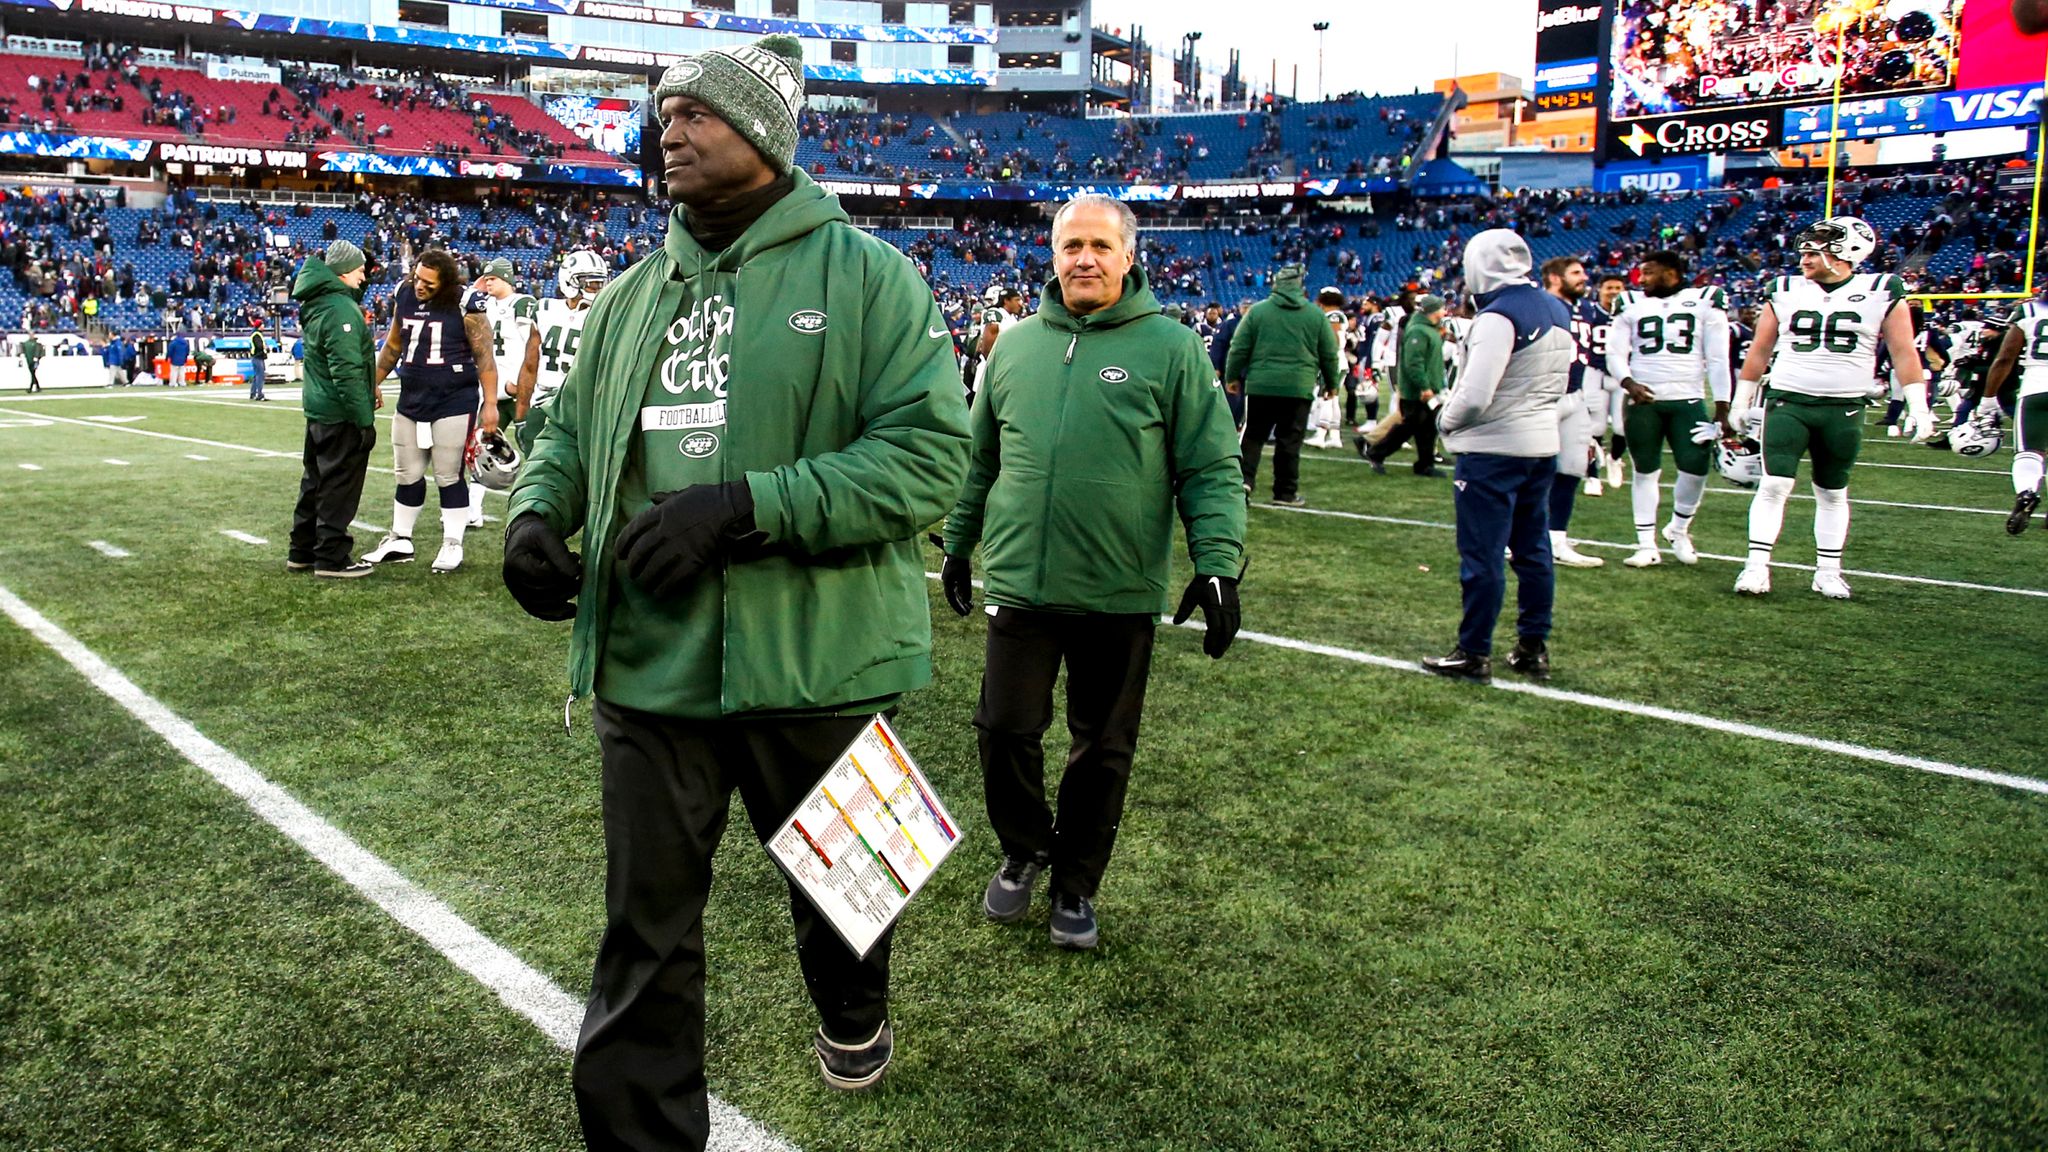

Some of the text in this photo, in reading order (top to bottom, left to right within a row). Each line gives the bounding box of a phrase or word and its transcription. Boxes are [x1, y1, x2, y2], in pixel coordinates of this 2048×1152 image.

[81, 0, 214, 25] PATRIOTS WIN
[583, 1, 684, 25] PATRIOTS WIN
[1536, 5, 1603, 32] jetBlue
[585, 47, 655, 66] PATRIOTS
[731, 46, 789, 89] ORK
[231, 68, 270, 79] Putnam
[1698, 71, 1777, 97] Party
[1537, 91, 1594, 109] 44:34
[1940, 87, 2044, 122] VISA
[1656, 119, 1769, 148] CROSS
[160, 143, 306, 168] PATRIOTS WIN
[872, 183, 901, 197] WIN
[1182, 183, 1295, 199] PATRIOTS WIN
[1620, 172, 1681, 193] BUD
[402, 318, 445, 364] 71
[1638, 313, 1696, 354] 93
[1789, 310, 1862, 353] 96
[541, 325, 582, 373] 45
[659, 407, 714, 426] FOOTBALL
